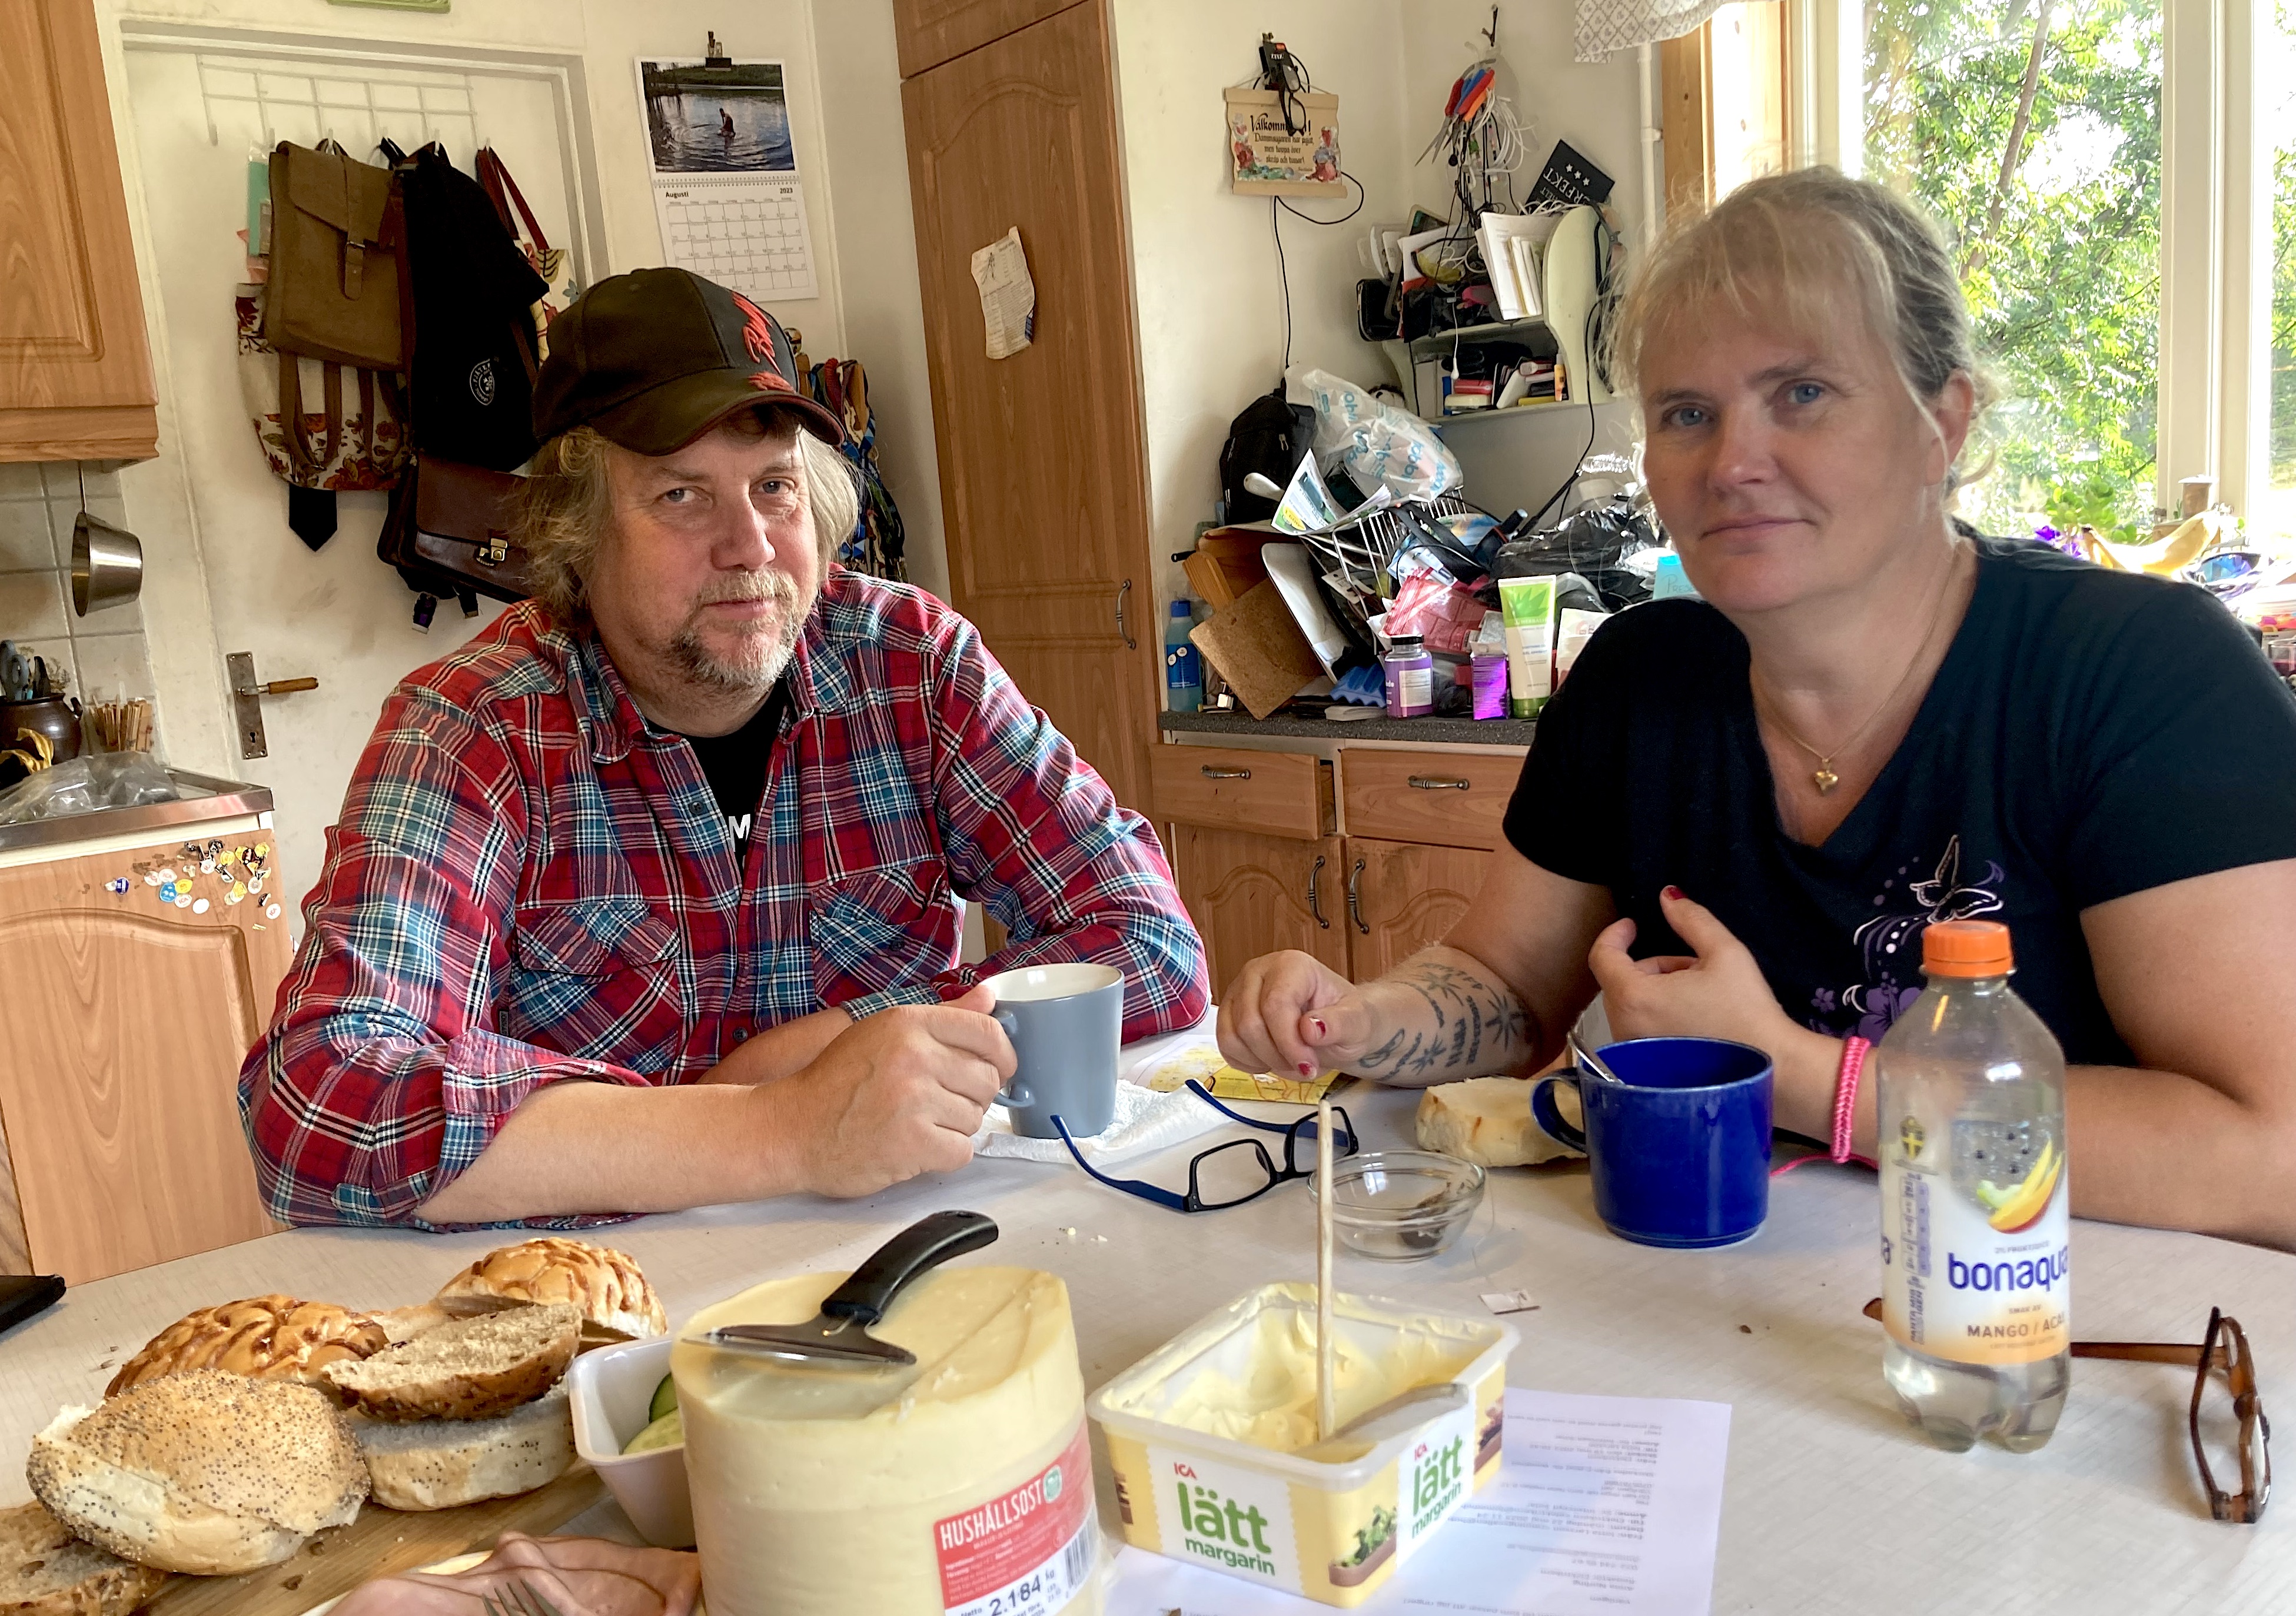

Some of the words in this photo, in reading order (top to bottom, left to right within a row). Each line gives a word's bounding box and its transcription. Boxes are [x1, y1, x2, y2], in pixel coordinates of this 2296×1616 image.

[1276, 145, 1290, 154] hoppa
[1948, 1246, 2068, 1292] bonaqua
[1968, 1324, 2029, 1338] MANGO
[1174, 1462, 1197, 1479] ICA
[1414, 1442, 1428, 1461] ICA
[1413, 1434, 1463, 1517] lätt
[940, 1478, 1044, 1551] HUSHÅLLSOST
[1177, 1482, 1272, 1554] lätt
[1411, 1482, 1463, 1539] margarin
[1185, 1537, 1275, 1577] margarin
[989, 1574, 1041, 1616] 2.184
